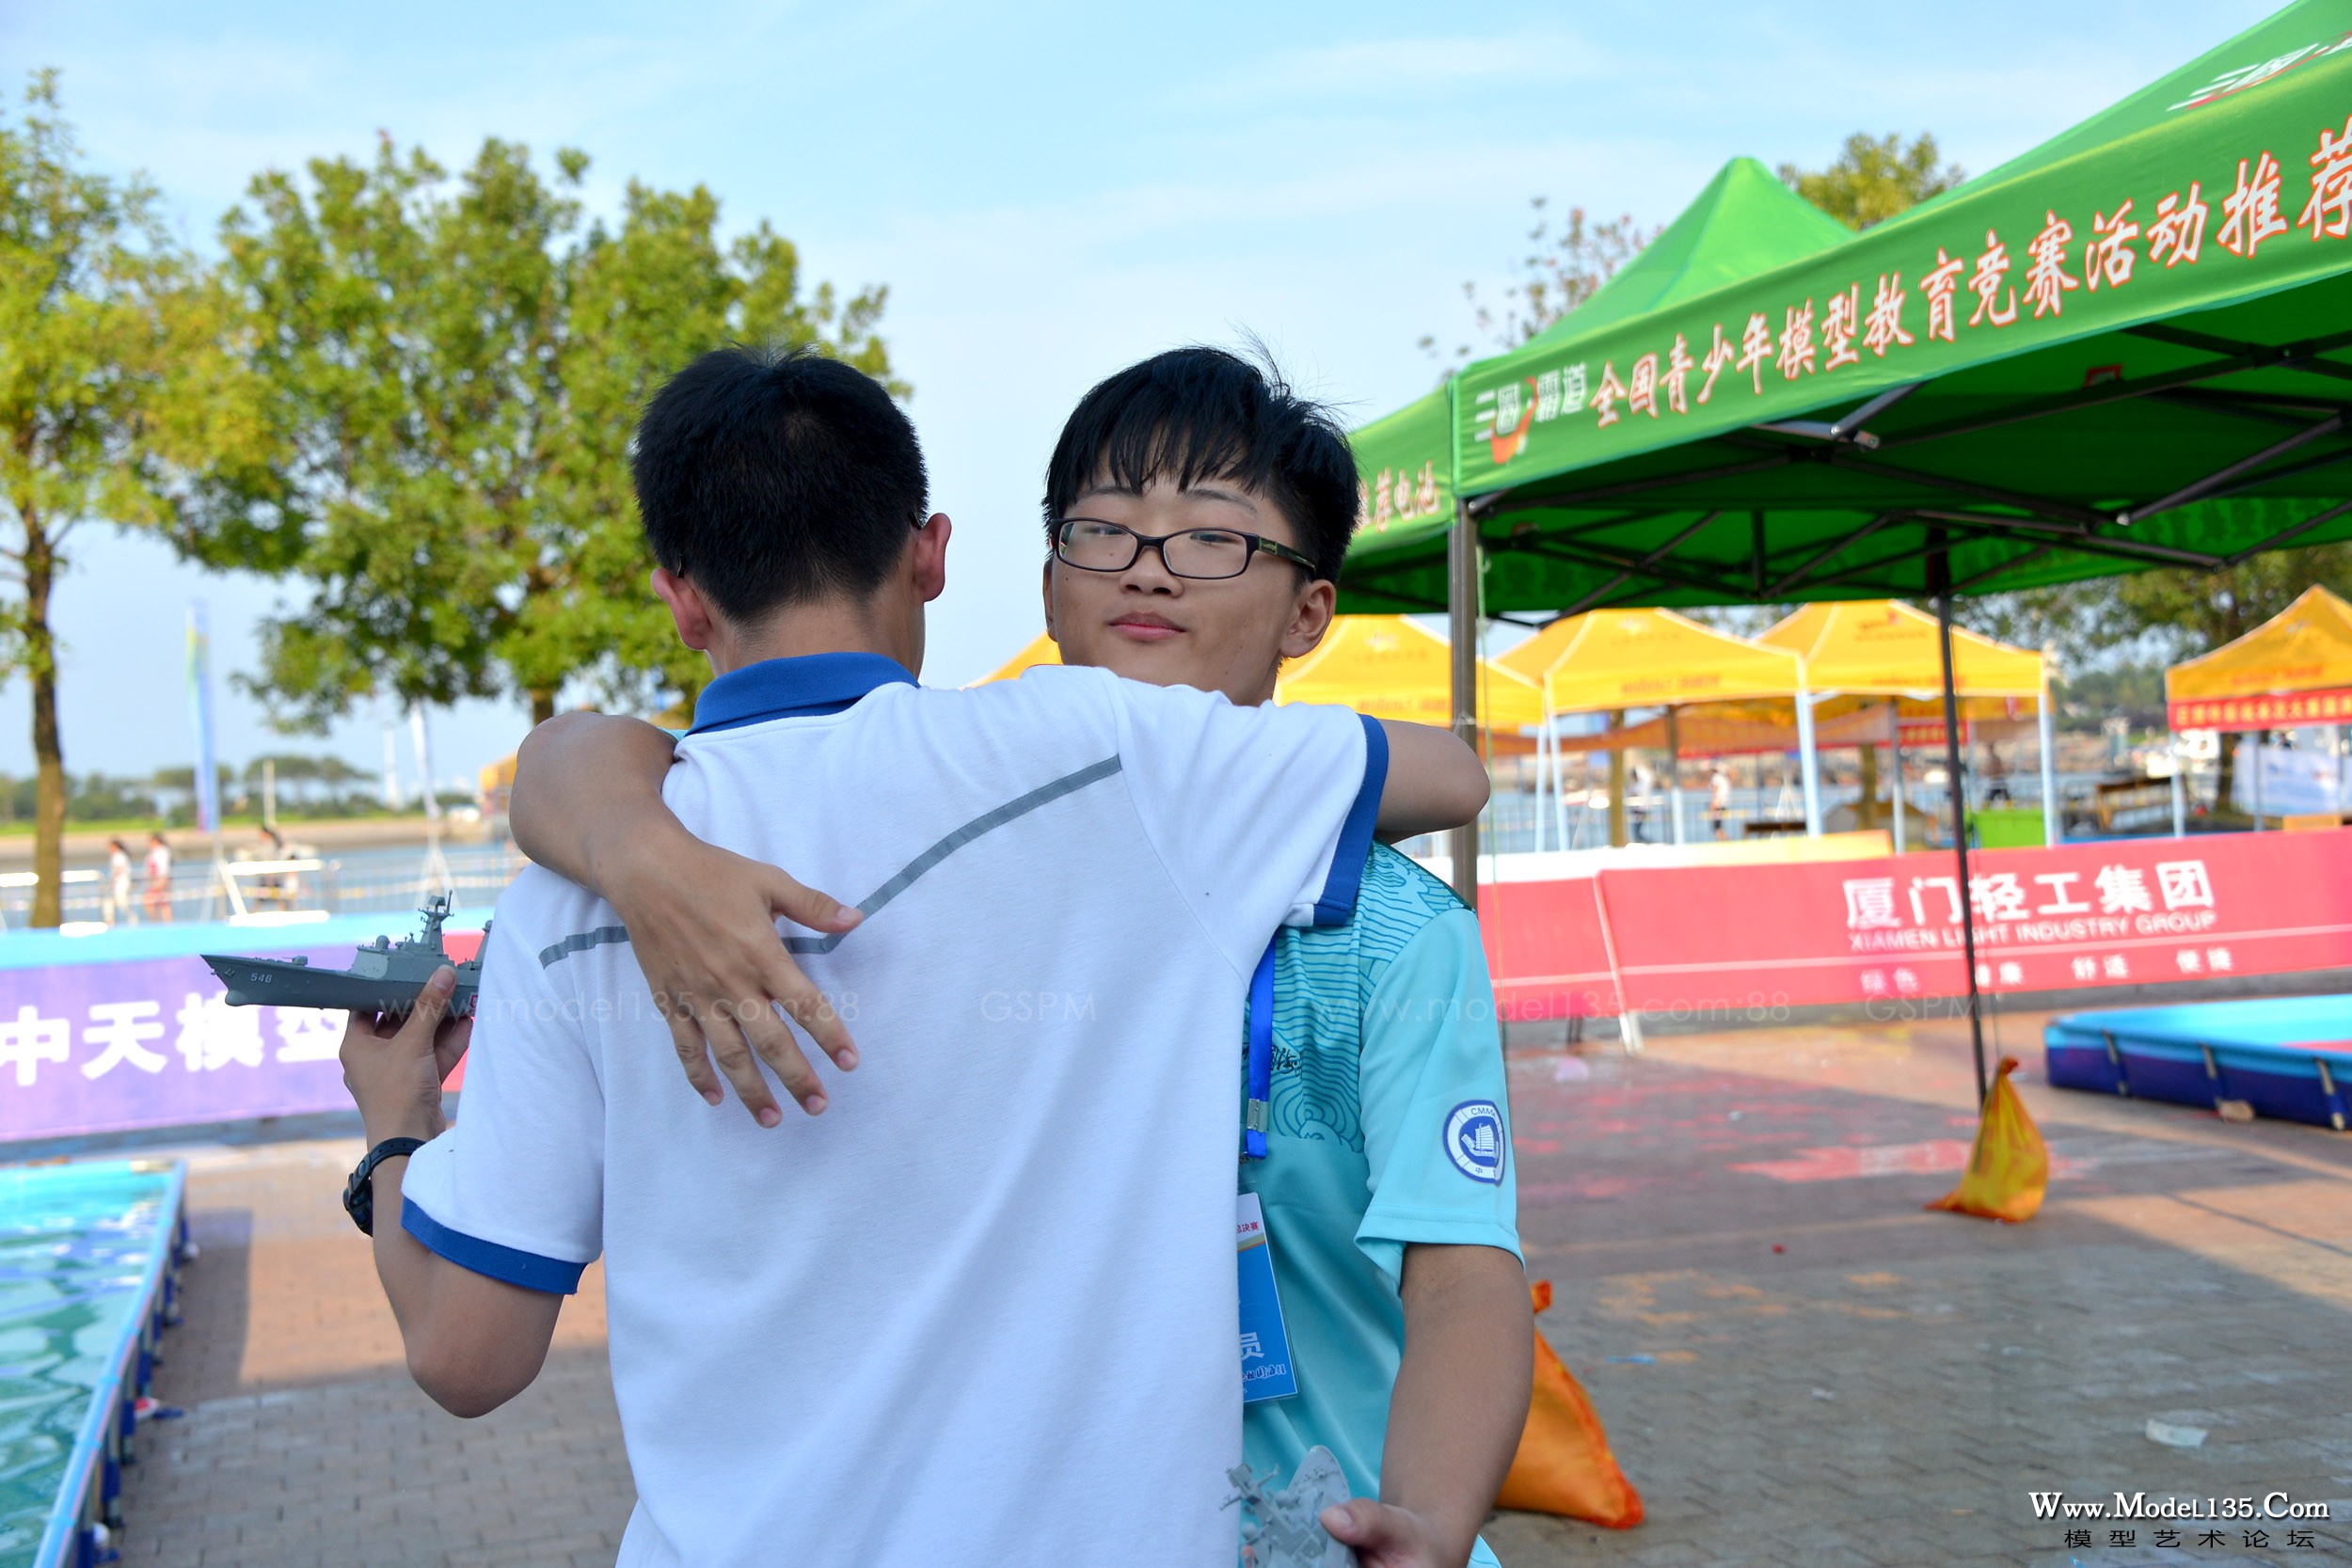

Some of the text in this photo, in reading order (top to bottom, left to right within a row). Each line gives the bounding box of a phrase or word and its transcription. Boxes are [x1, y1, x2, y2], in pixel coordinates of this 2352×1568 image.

[1842, 860, 2216, 929] 厦门轻工集团
[1848, 929, 1937, 952] XIAMEN
[2015, 916, 2129, 942] INDUSTRY
[2135, 911, 2218, 936] GROUP
[250, 972, 274, 984] 546
